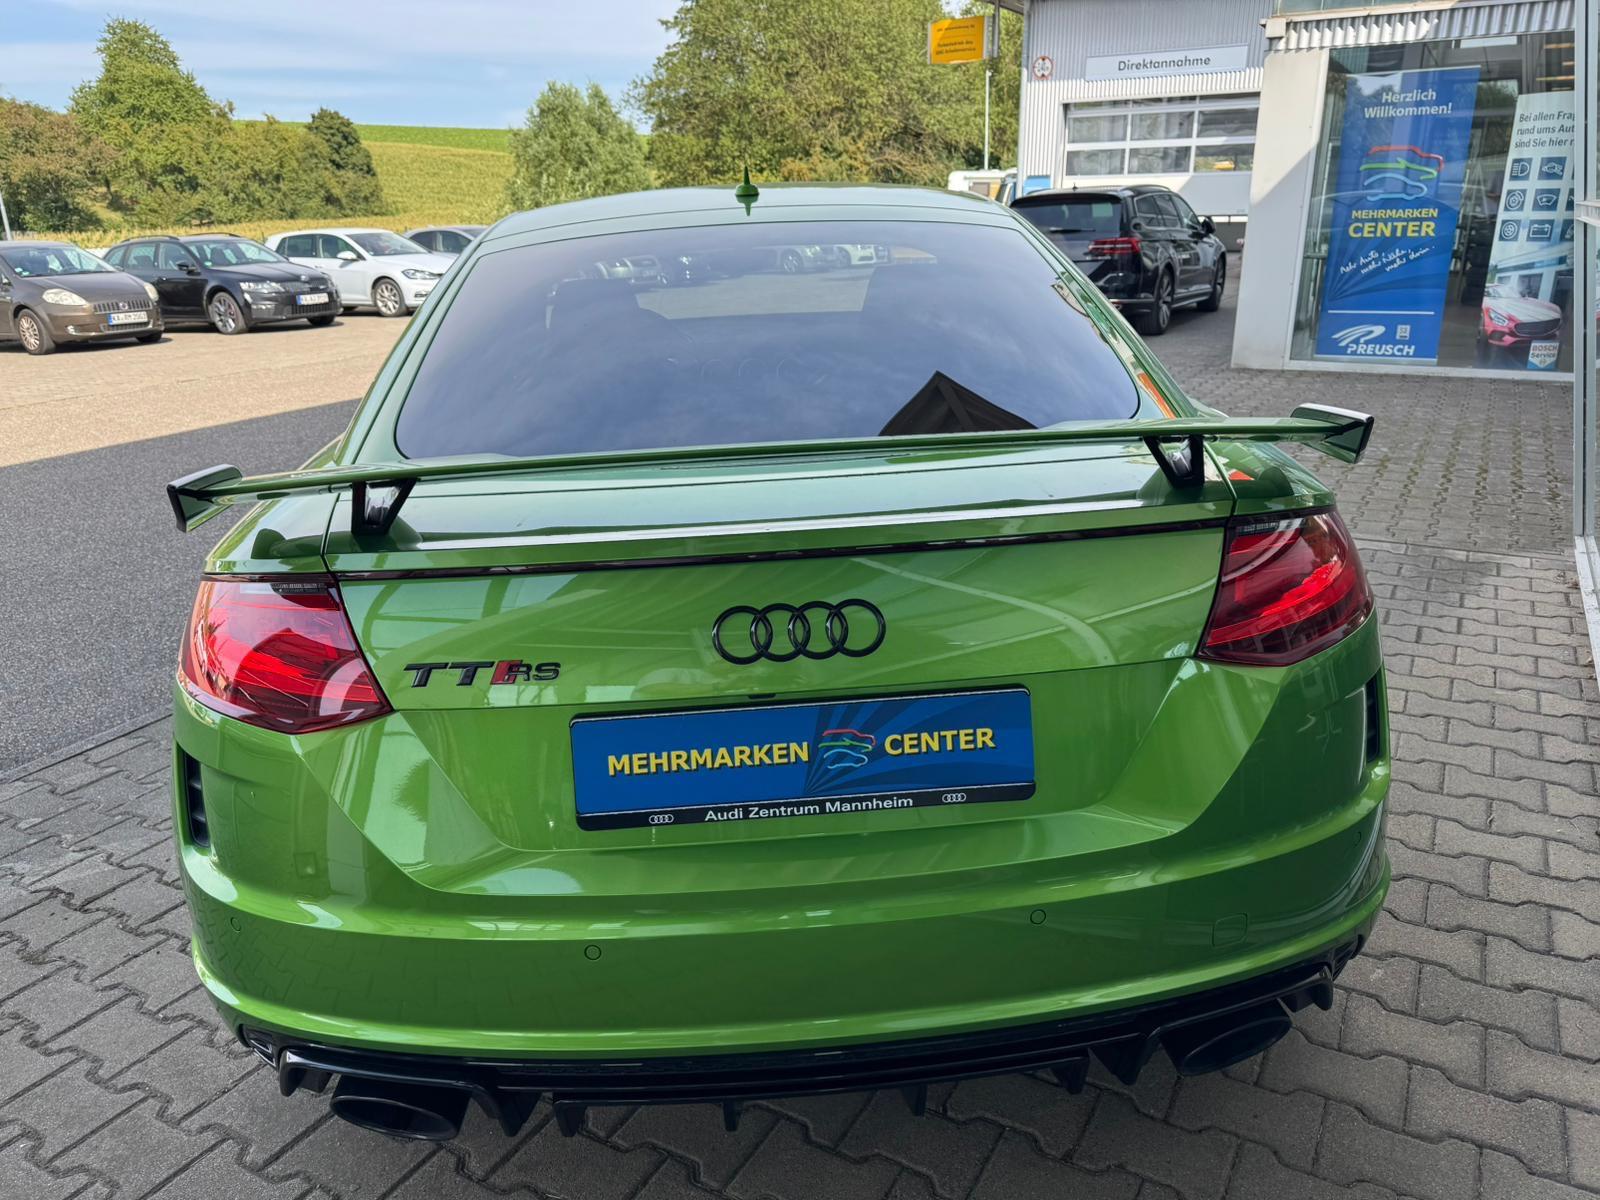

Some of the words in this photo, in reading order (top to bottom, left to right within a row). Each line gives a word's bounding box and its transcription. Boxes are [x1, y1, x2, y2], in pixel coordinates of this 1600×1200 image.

[1118, 56, 1211, 71] Direktannahme
[1382, 88, 1437, 103] Herzlich
[1364, 102, 1452, 118] Willkommen!
[1519, 113, 1532, 122] Bei
[1533, 112, 1555, 121] allen
[1517, 126, 1535, 135] rund
[1536, 125, 1556, 134] ums
[1514, 139, 1531, 148] sind
[1532, 138, 1547, 148] Sie
[1548, 137, 1568, 146] hier
[1351, 207, 1438, 219] MEHRMARKEN
[1348, 221, 1435, 237] CENTER
[1346, 344, 1415, 356] PREUSCH
[1532, 343, 1558, 351] BOSCH
[403, 661, 495, 688] TT
[503, 661, 561, 682] RS
[607, 741, 809, 777] MEHRMARKEN
[884, 728, 996, 756] CENTER
[705, 808, 743, 822] Audi
[748, 804, 820, 819] Zentrum
[826, 796, 913, 814] Mannheim
